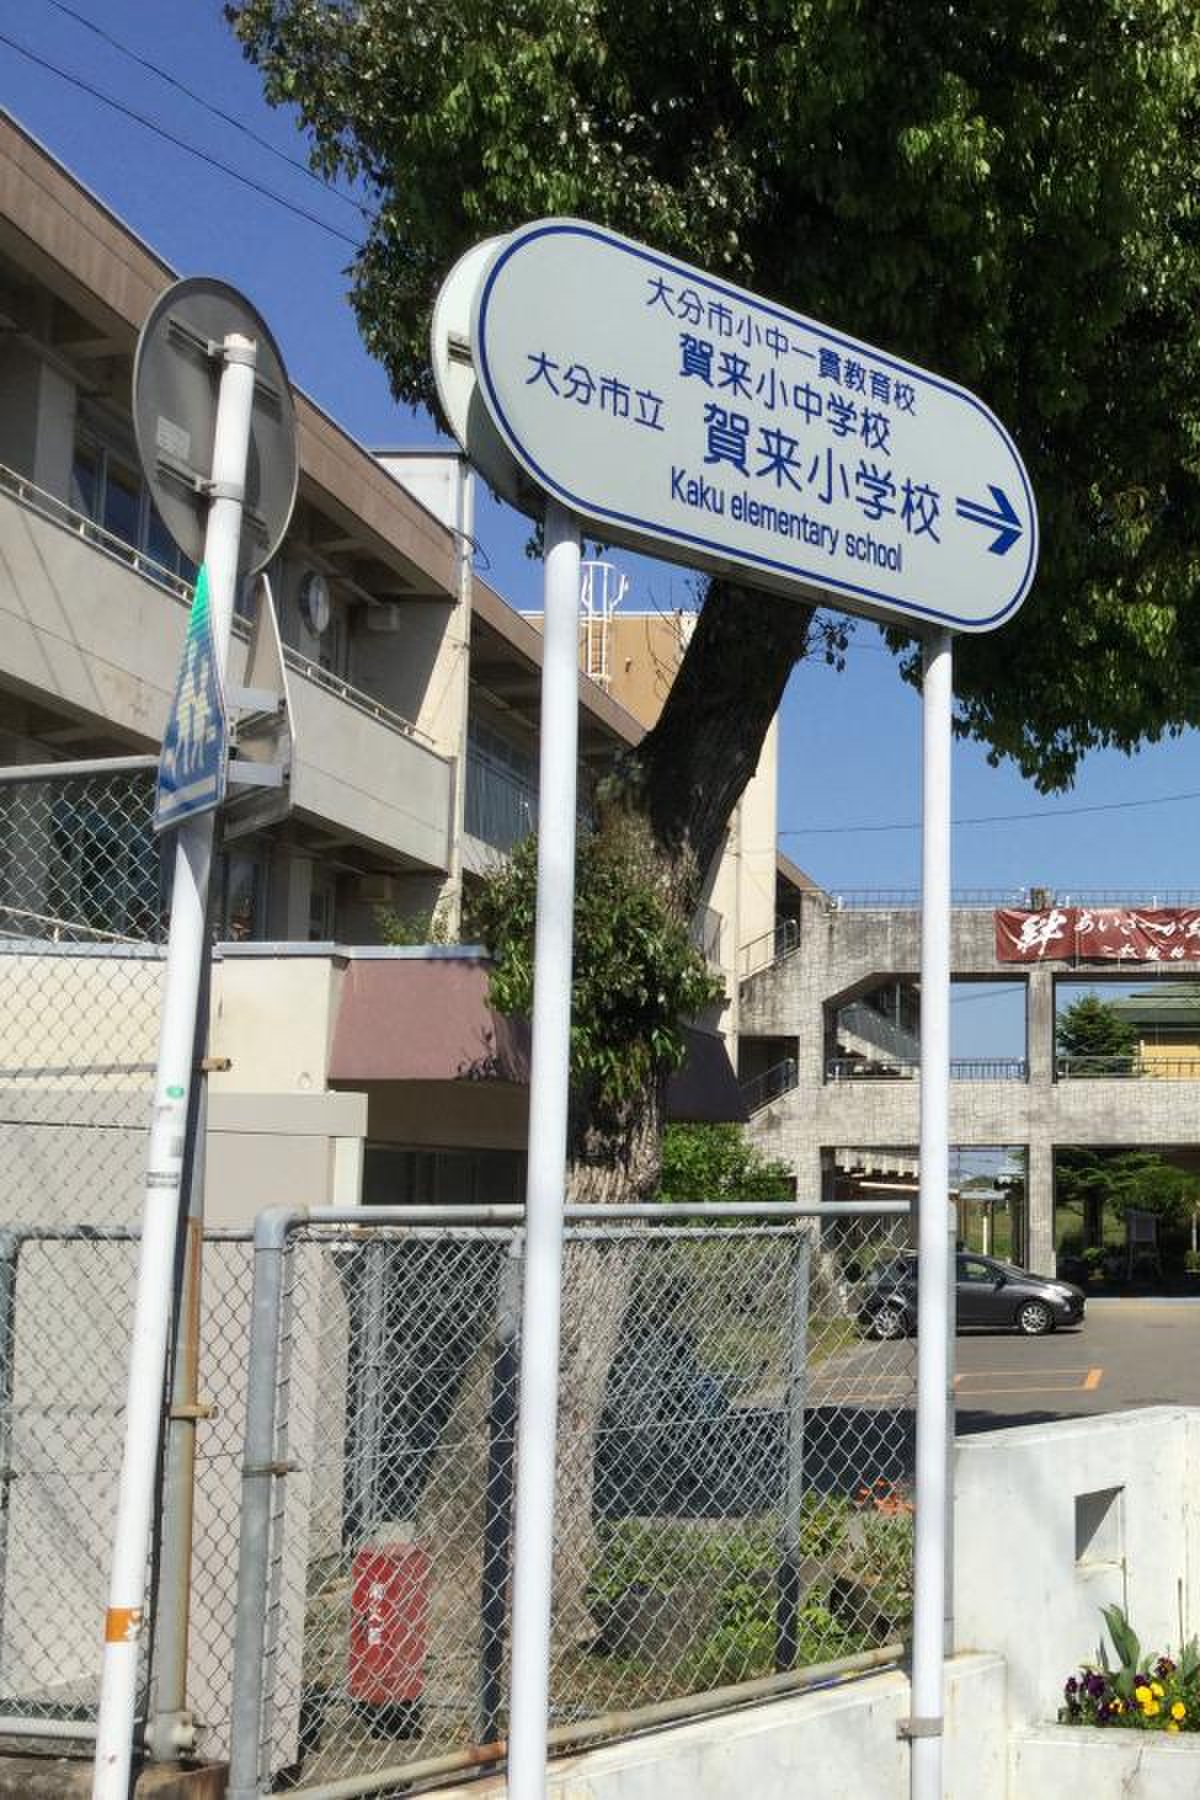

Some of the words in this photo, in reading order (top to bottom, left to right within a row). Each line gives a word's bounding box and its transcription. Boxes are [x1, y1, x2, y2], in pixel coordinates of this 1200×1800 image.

[526, 352, 666, 431] 大分市立
[647, 277, 916, 417] 大分市小中一貫教育校
[680, 333, 891, 456] 賀来小中学校
[671, 466, 724, 515] Kaku
[731, 491, 839, 556] elementary
[846, 530, 902, 573] school
[703, 403, 941, 544] 賀来小学校
